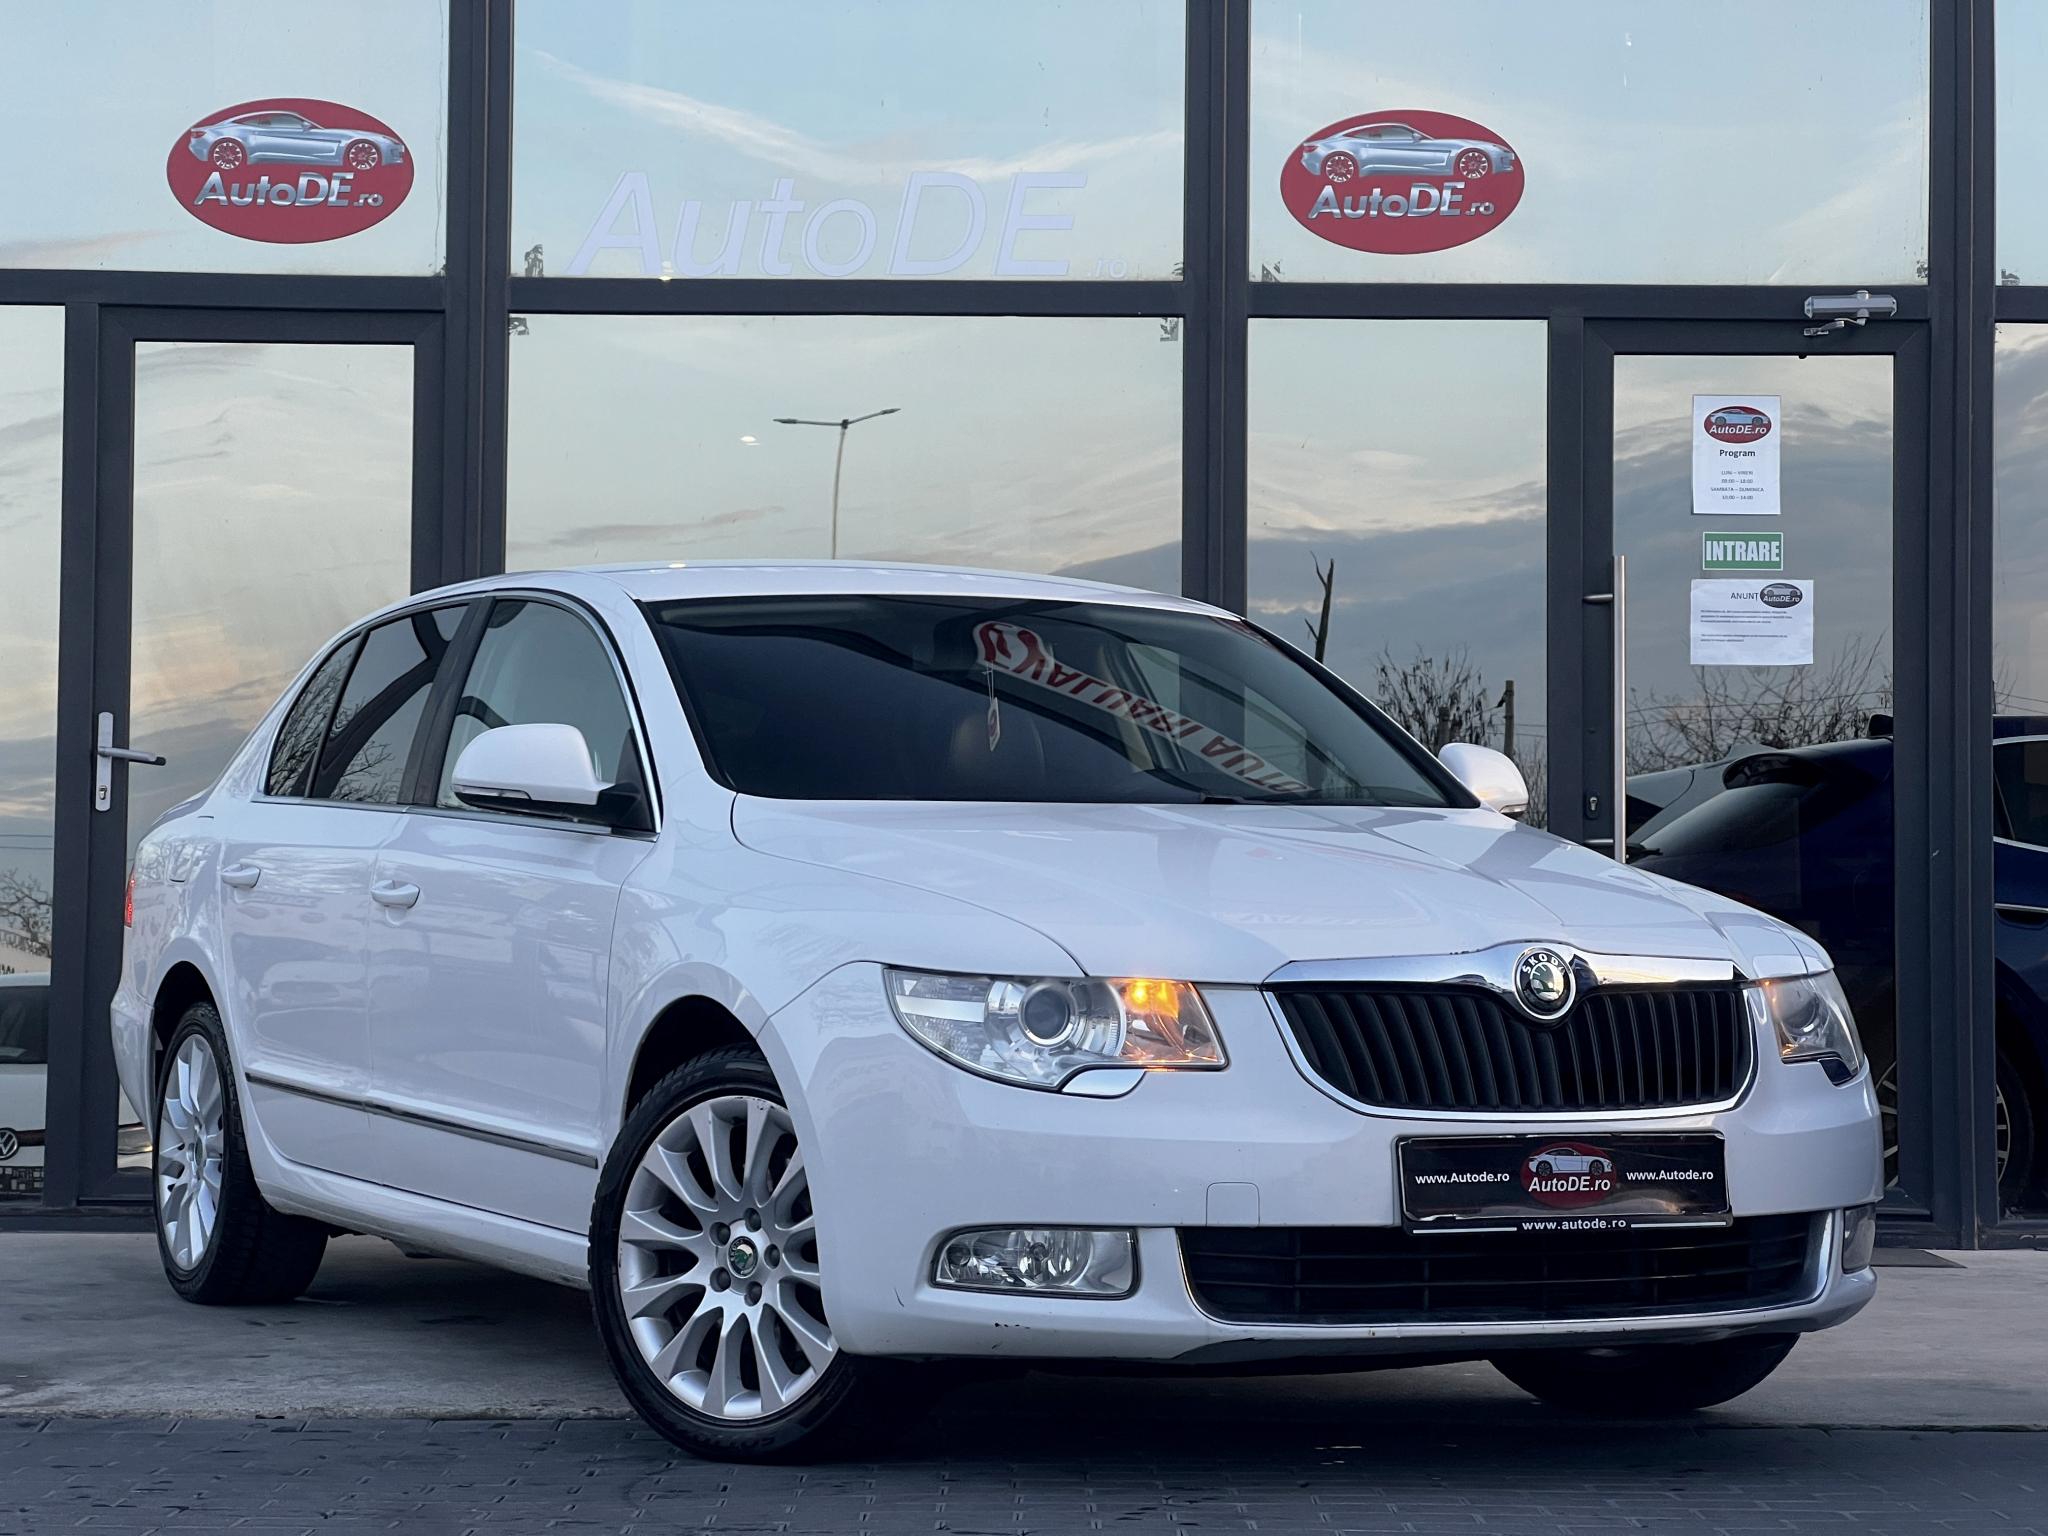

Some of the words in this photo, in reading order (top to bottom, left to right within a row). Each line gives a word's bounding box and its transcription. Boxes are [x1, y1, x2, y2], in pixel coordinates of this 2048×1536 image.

[1709, 424, 1767, 435] AutoDE.ro
[1719, 449, 1756, 459] Program
[1705, 540, 1780, 562] INTRARE
[1415, 1171, 1510, 1184] www.Autode.ro
[1626, 1169, 1714, 1182] www.Autode.ro
[1528, 1175, 1612, 1193] AutoDE.ro
[1522, 1217, 1627, 1231] www.autode.ro
